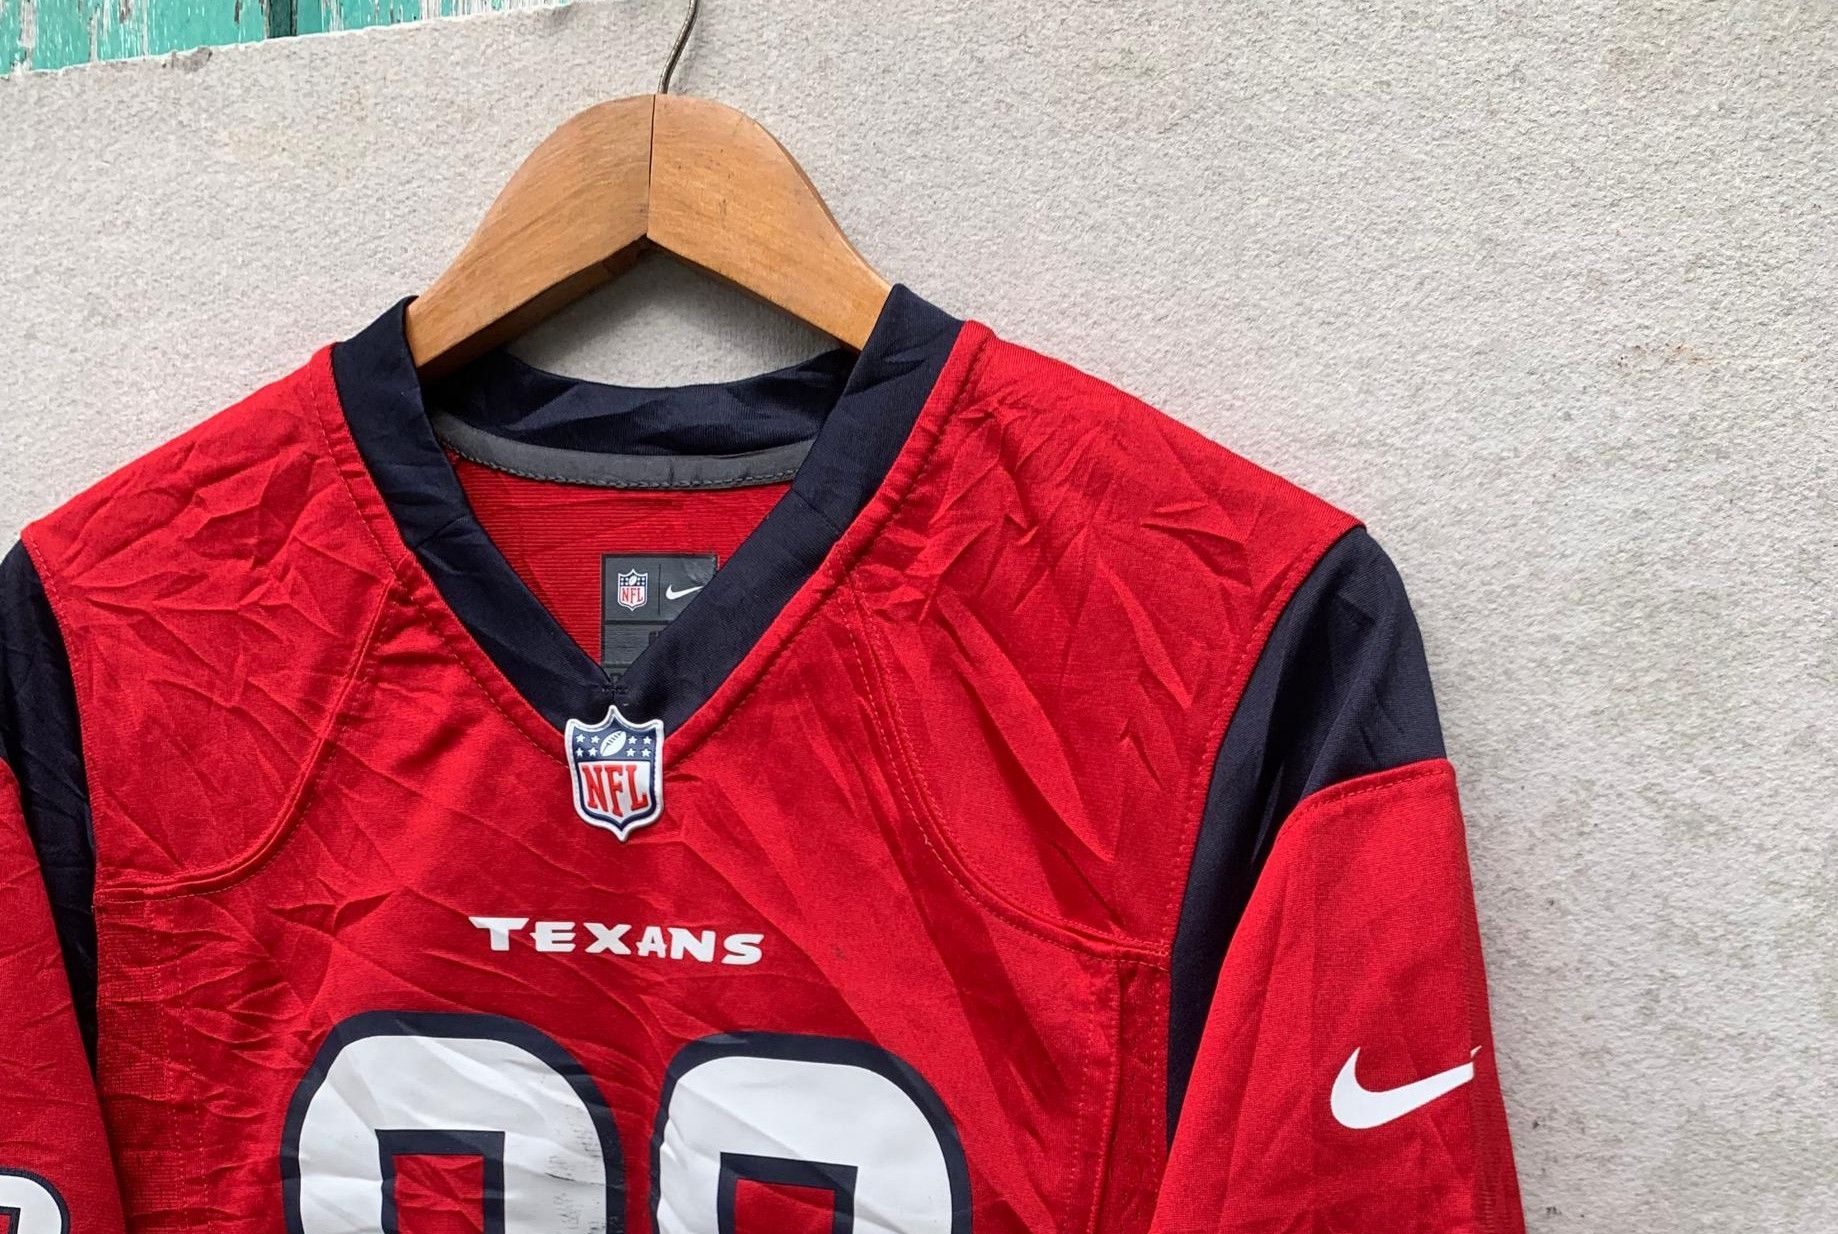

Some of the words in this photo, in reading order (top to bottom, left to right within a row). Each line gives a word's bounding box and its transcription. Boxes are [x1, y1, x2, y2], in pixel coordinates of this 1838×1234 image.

[621, 587, 644, 604] NFL
[581, 763, 648, 818] NFL
[468, 915, 765, 966] TEXANS
